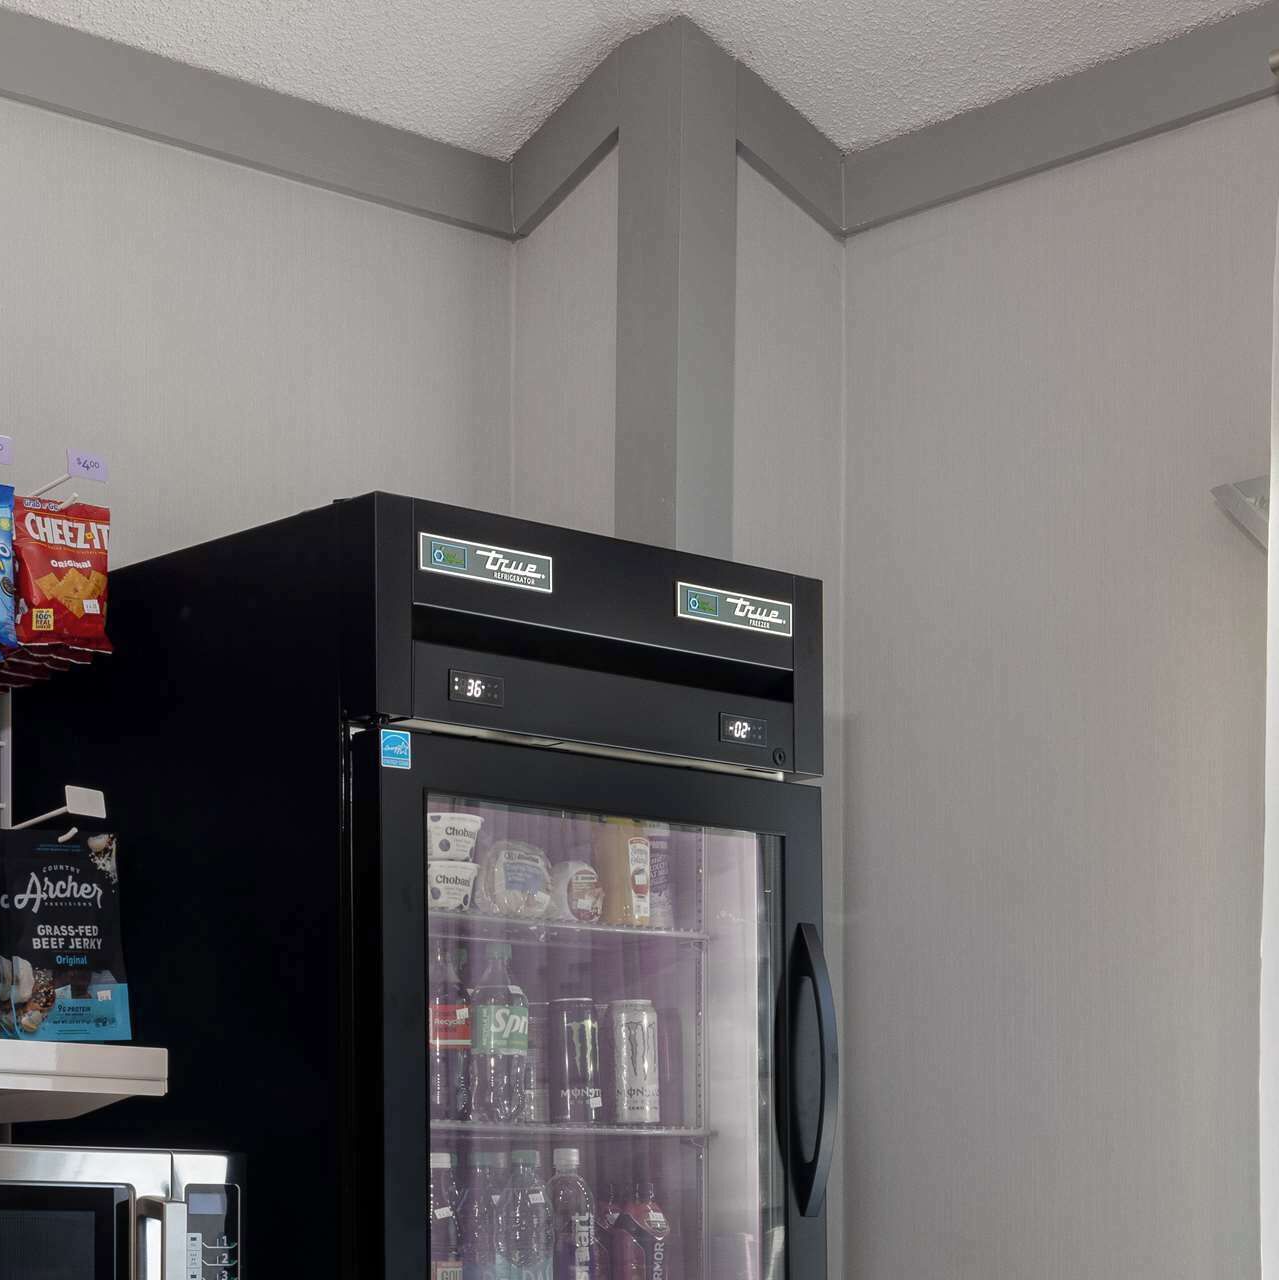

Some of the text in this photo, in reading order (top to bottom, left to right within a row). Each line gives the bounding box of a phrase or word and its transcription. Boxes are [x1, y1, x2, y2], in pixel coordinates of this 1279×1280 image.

[476, 550, 542, 579] true
[494, 572, 535, 584] REFRIGERATOR
[726, 598, 782, 624] true
[750, 619, 770, 628] FREEZER
[467, 679, 481, 697] 36
[42, 864, 80, 874] COUNTRY
[14, 871, 103, 914] Archer
[37, 925, 98, 936] GRASS-FED
[33, 937, 102, 949] BEEF JERKY
[56, 955, 87, 966] Original
[222, 1236, 228, 1246] 1
[222, 1254, 228, 1263] 2
[222, 1271, 228, 1280] 3
